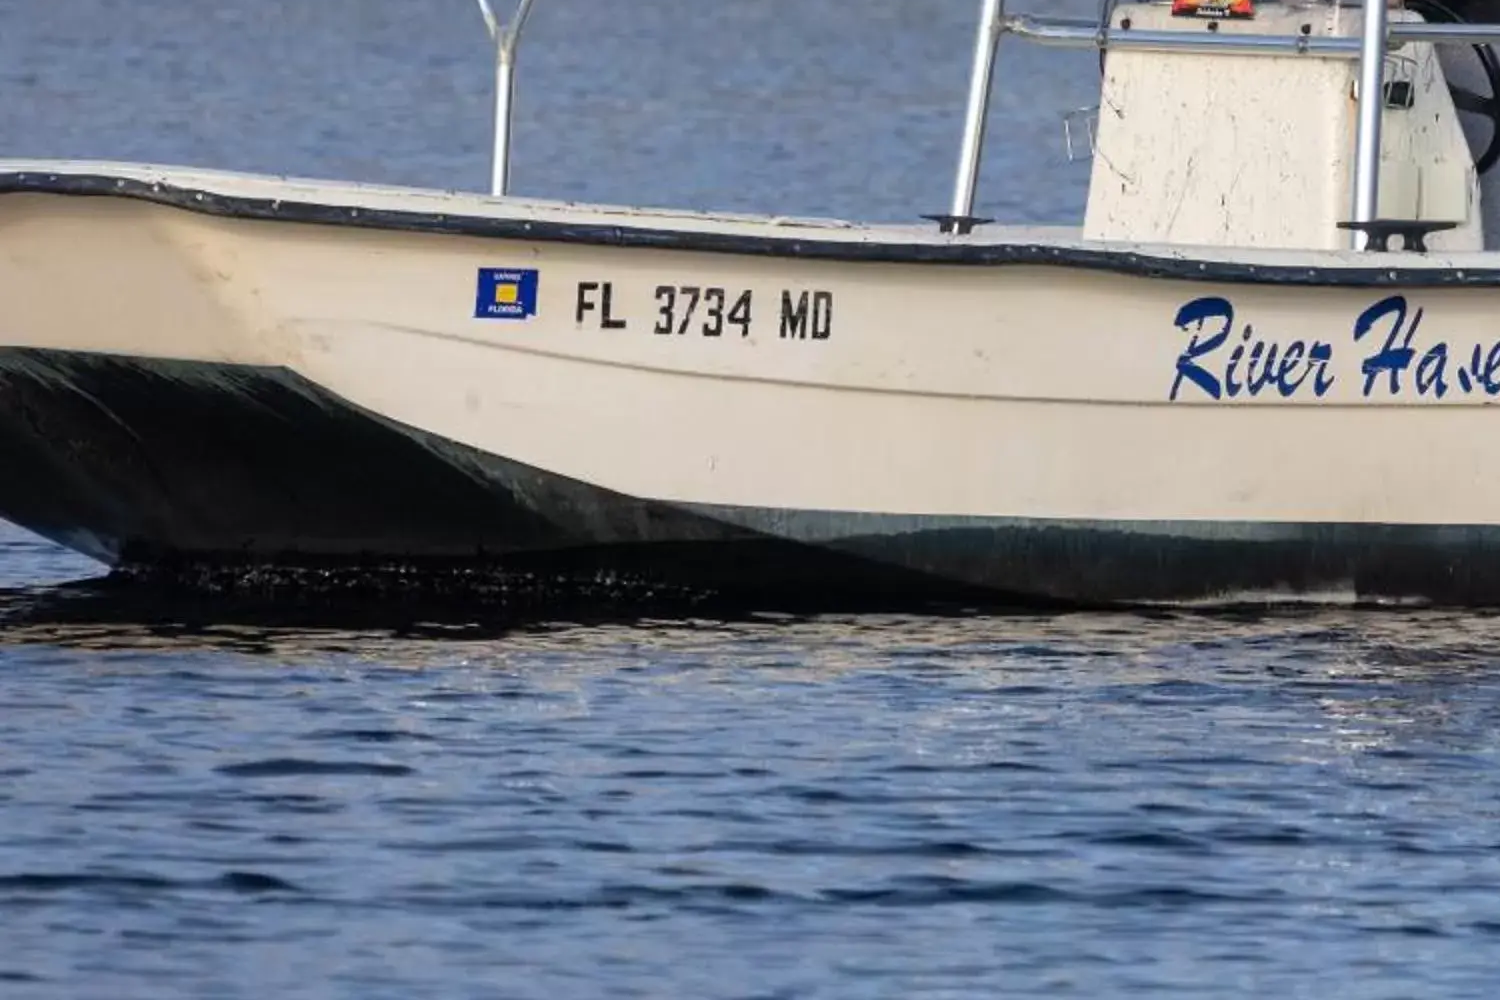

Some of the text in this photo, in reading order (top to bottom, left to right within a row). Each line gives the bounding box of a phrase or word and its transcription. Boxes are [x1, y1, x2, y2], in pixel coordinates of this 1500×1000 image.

[576, 282, 832, 340] FL 3734 MD
[1170, 296, 1335, 401] River
